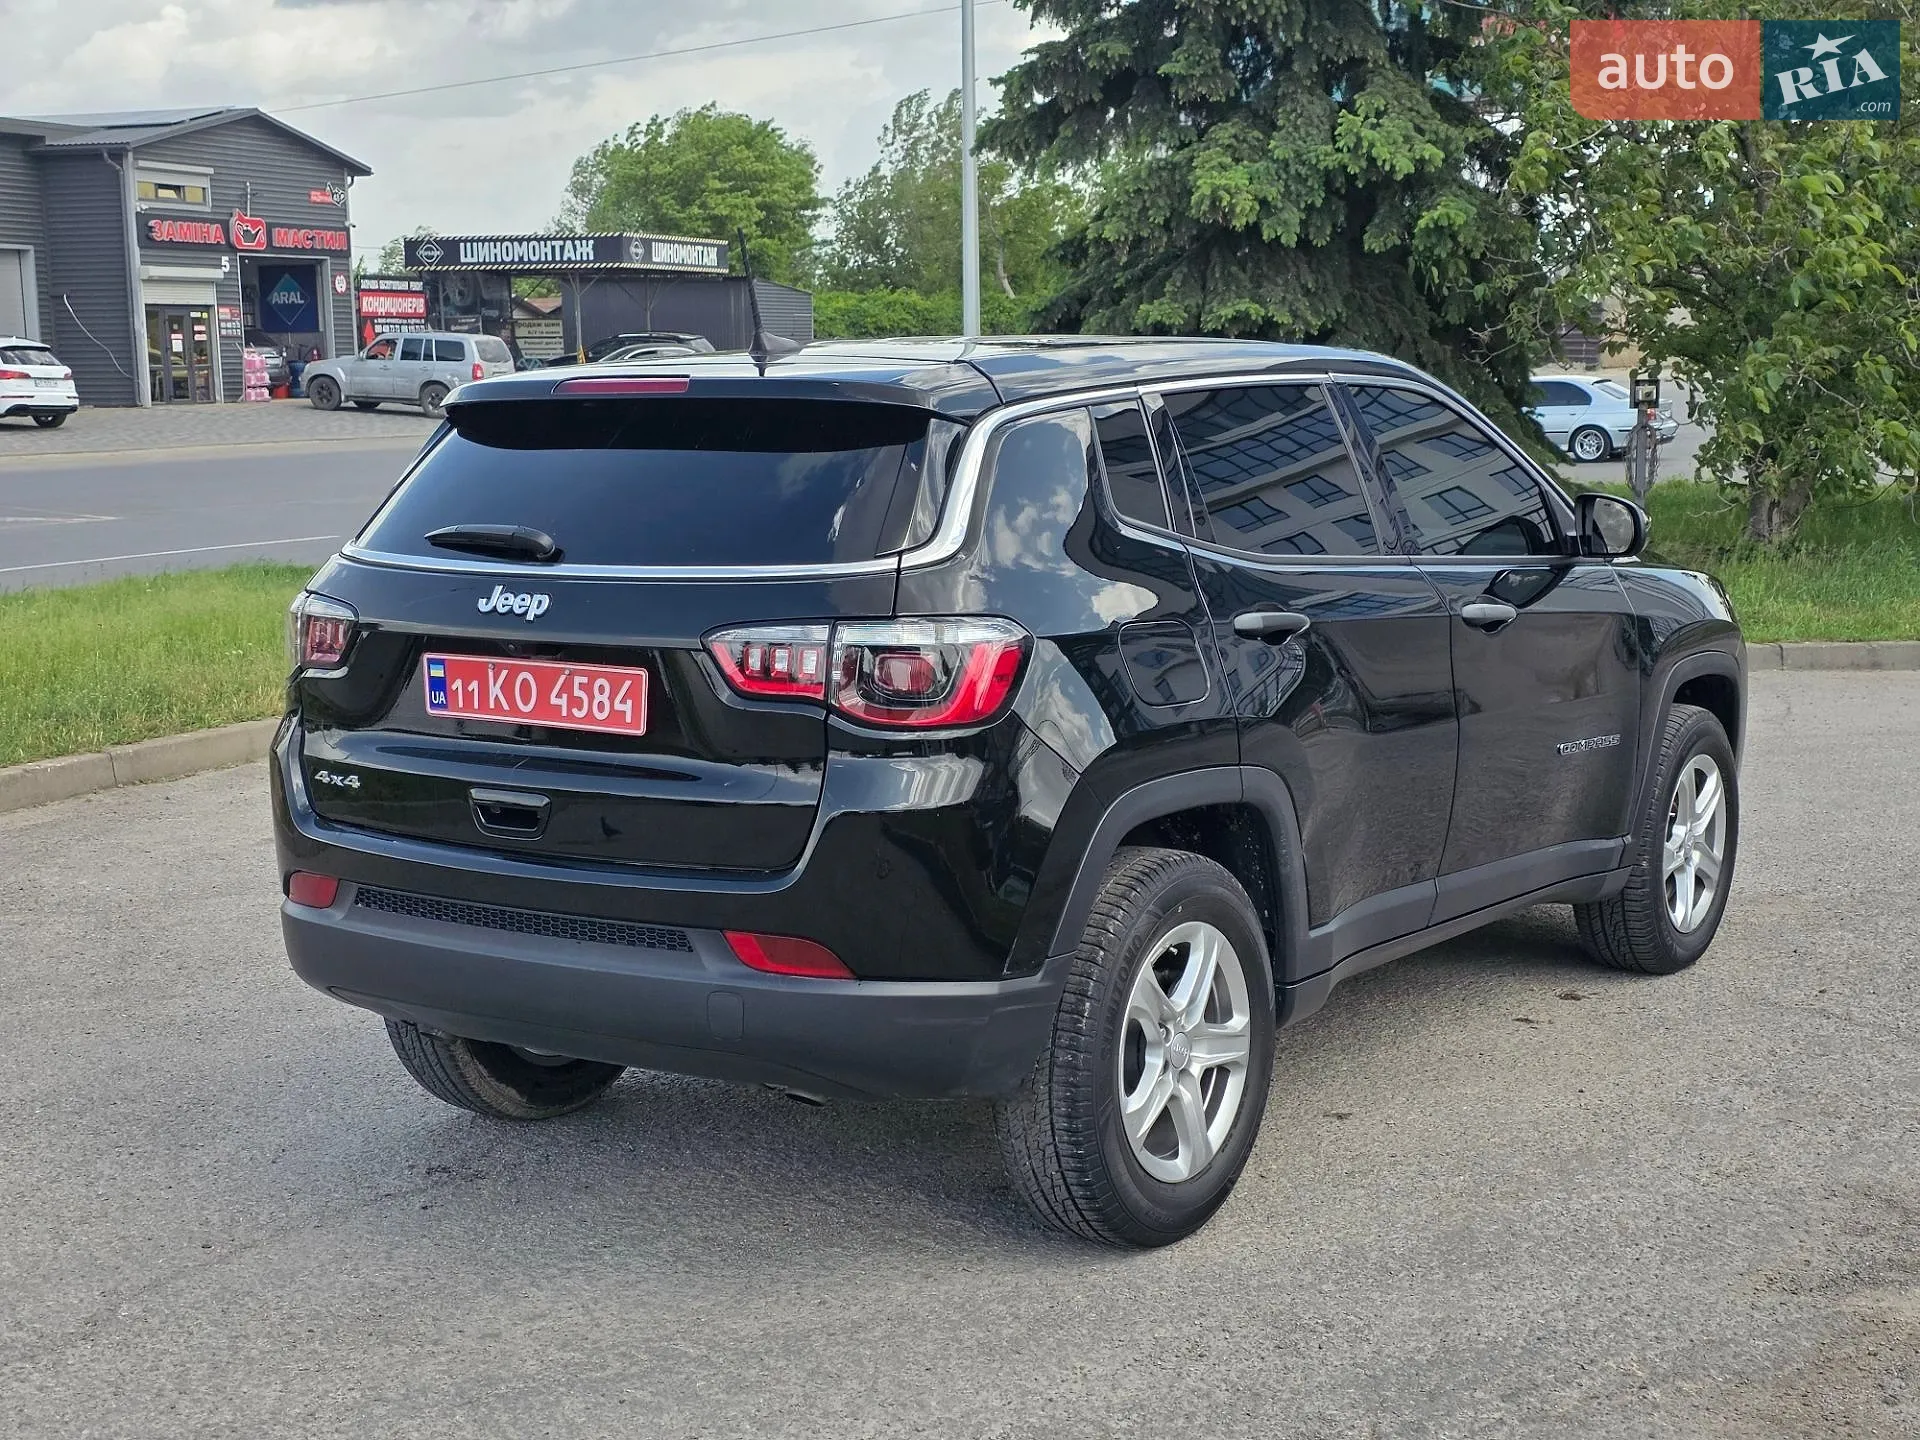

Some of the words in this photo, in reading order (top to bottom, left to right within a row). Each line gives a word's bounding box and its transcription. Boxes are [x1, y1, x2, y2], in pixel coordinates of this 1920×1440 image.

[148, 218, 225, 245] ЗАМІНА
[272, 228, 348, 250] МАСТИЛ
[459, 239, 595, 263] ШИНОМОНТАЖ
[651, 241, 718, 266] ШИНОМОНТАЖ
[221, 256, 230, 272] 5
[272, 291, 305, 305] ARAL
[362, 296, 425, 316] КОНДИЦІОНЕРІВ
[478, 584, 551, 621] Jeep
[431, 691, 447, 706] UA
[550, 669, 633, 724] 4584
[1559, 734, 1621, 755] COMPASS
[314, 770, 361, 789] 4x4
